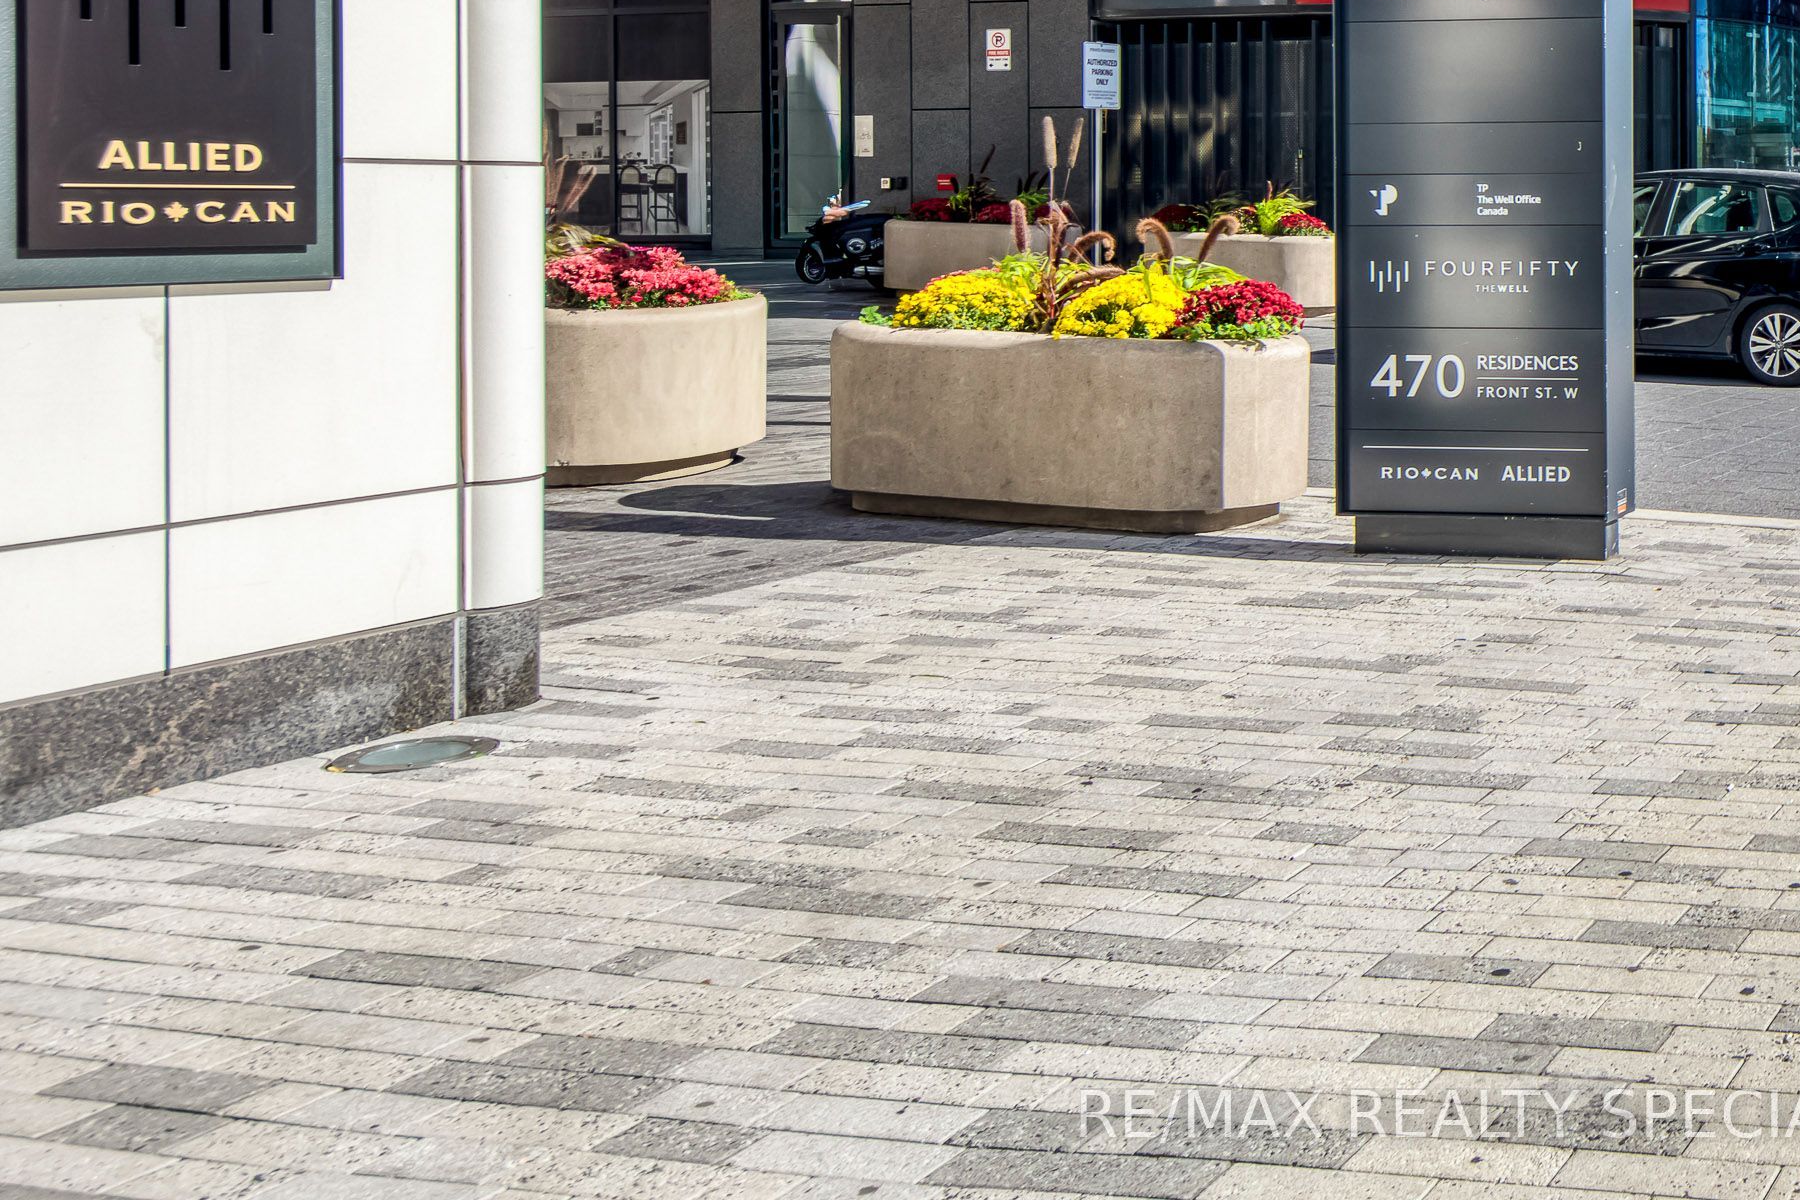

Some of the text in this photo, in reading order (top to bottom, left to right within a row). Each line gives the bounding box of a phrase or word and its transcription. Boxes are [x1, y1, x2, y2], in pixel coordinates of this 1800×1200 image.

[1087, 59, 1118, 67] AUTHORIZED
[1096, 78, 1109, 86] ONLY
[98, 139, 264, 172] ALLIED
[1477, 183, 1489, 193] TP
[1477, 195, 1541, 204] The Well Office
[1477, 206, 1508, 216] Canada
[1424, 260, 1580, 277] FOURFIFTY
[1477, 355, 1579, 371] RESIDENCES
[1370, 354, 1466, 398] 470
[1477, 387, 1579, 399] FRONT ST. W
[1502, 465, 1571, 482] ALLIED
